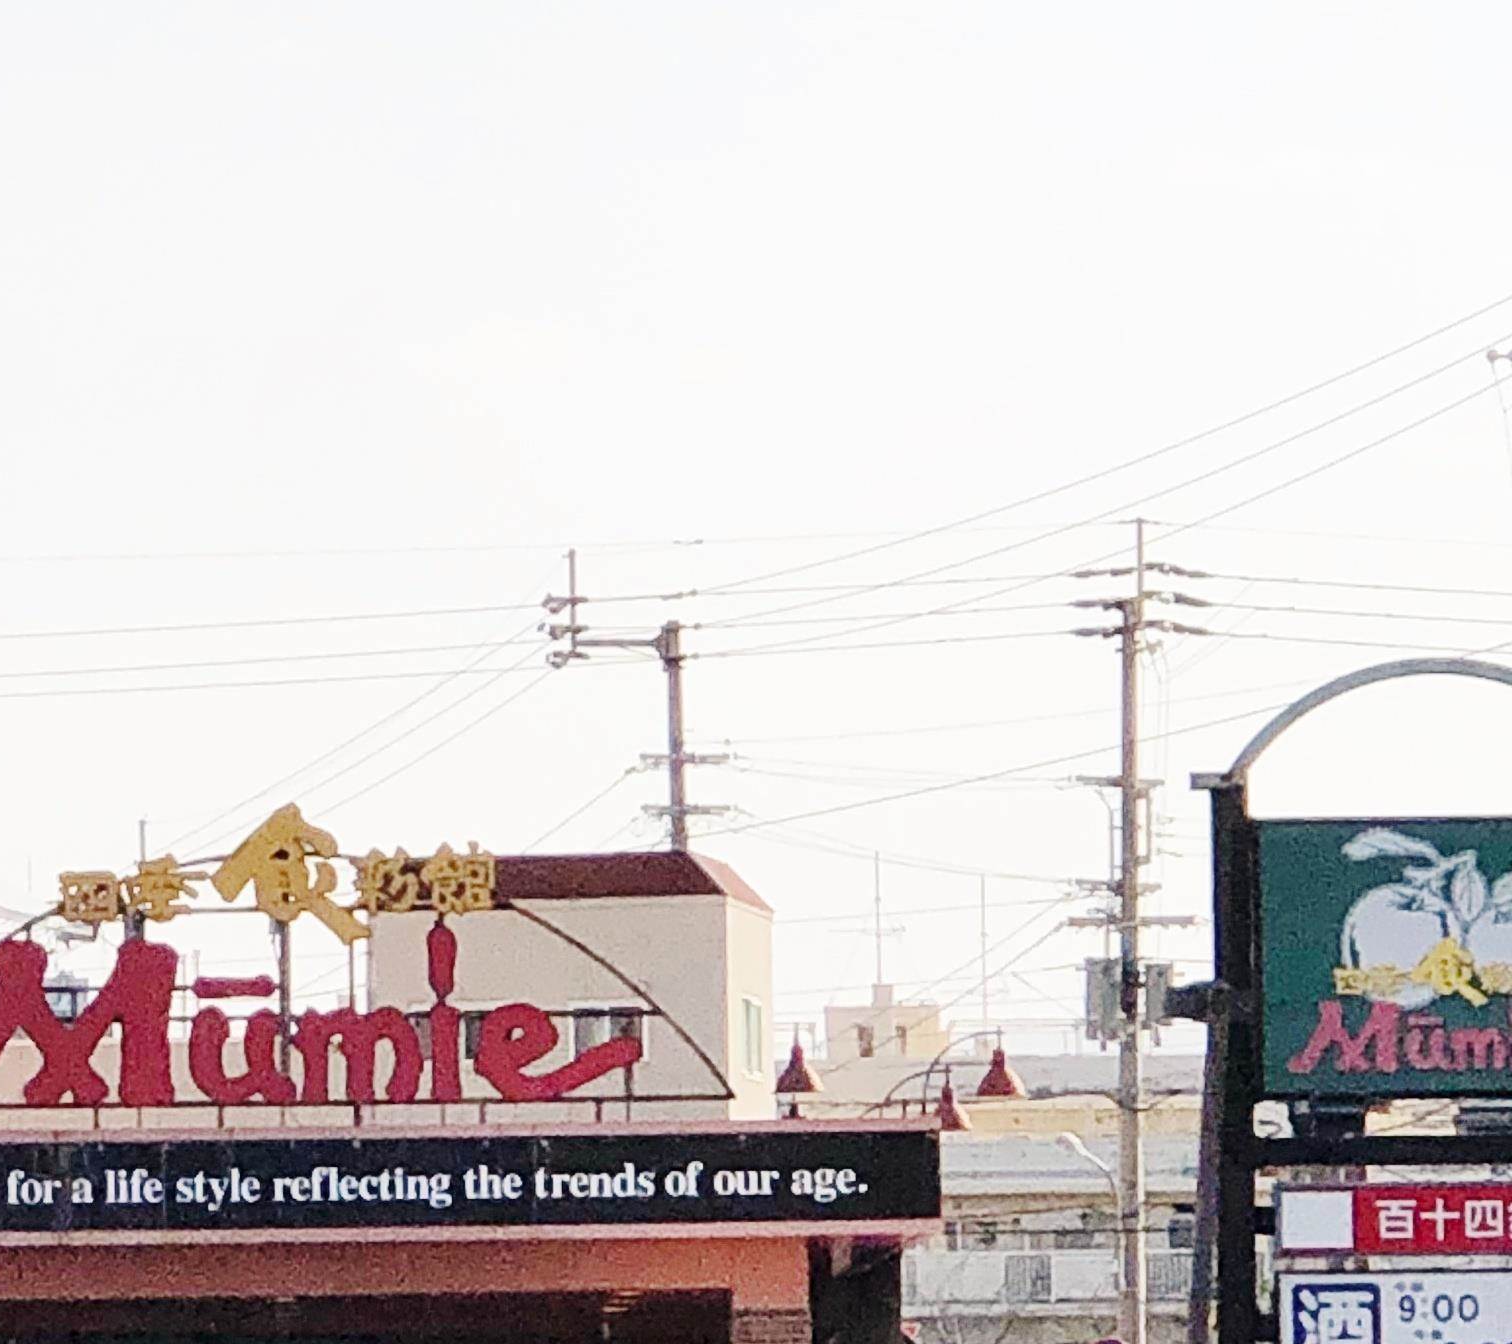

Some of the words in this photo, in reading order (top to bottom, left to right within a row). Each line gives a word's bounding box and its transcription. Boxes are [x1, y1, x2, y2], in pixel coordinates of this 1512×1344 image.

[59, 802, 495, 945] 四季食彩館
[1287, 1000, 1512, 1074] Mūm
[7, 1169, 62, 1204] for
[71, 1177, 94, 1204] a
[105, 1168, 164, 1203] life
[176, 1167, 261, 1211] style
[273, 1166, 452, 1208] reflecting
[463, 1164, 523, 1199] the
[534, 1162, 656, 1199] trends
[664, 1160, 704, 1197] of
[713, 1169, 780, 1196] our
[790, 1167, 868, 1203] age.
[1375, 1197, 1512, 1241] 百十四
[1399, 1294, 1480, 1323] 9:00
